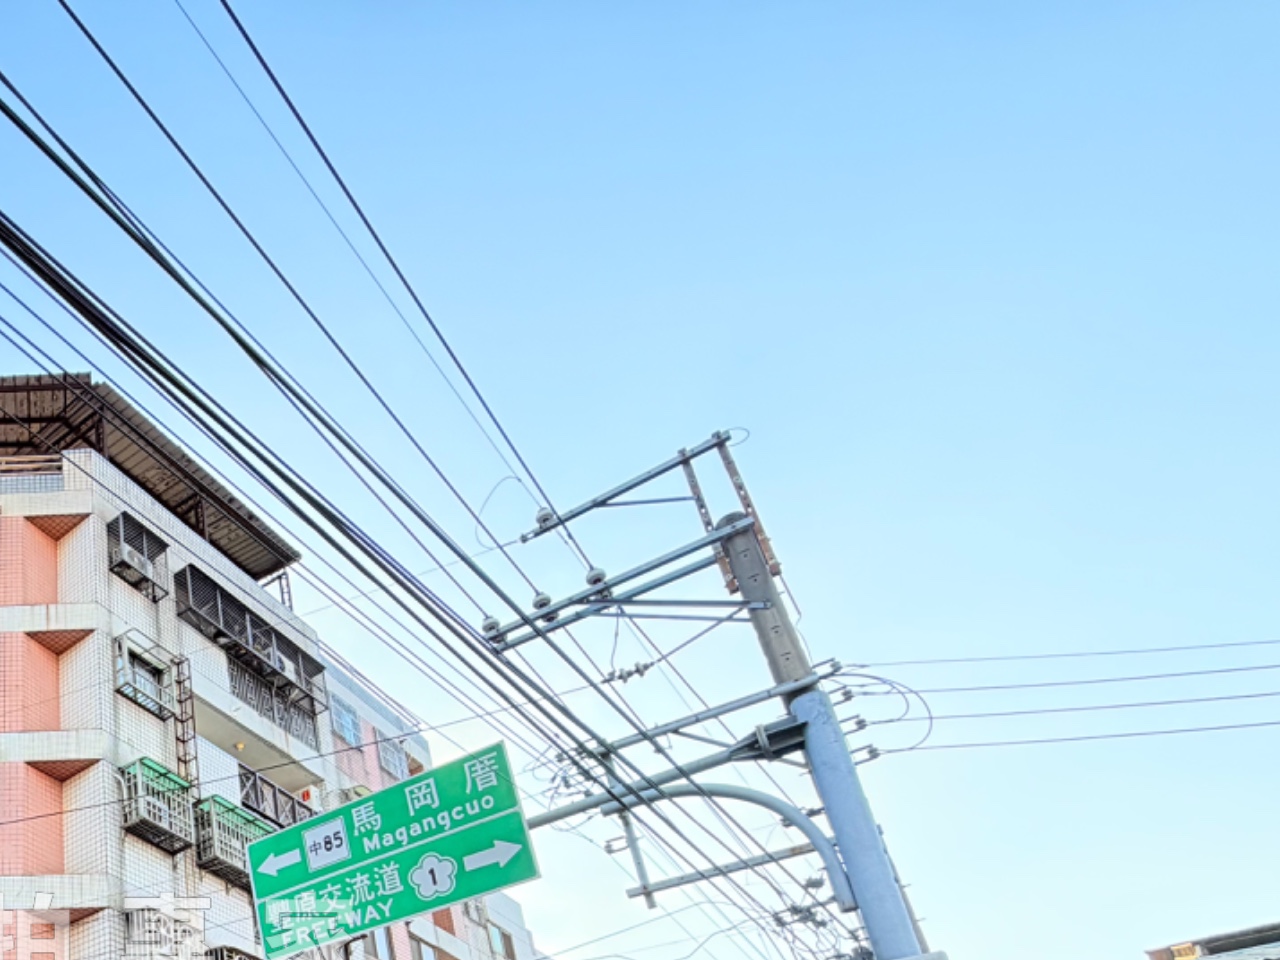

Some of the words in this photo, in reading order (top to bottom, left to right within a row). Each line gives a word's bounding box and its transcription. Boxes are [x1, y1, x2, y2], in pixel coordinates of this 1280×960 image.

[352, 751, 500, 837] 馬岡厝
[308, 830, 345, 856] 中85
[362, 793, 495, 854] Magangcuo
[428, 867, 439, 887] 1
[280, 898, 394, 946] FREEWAY
